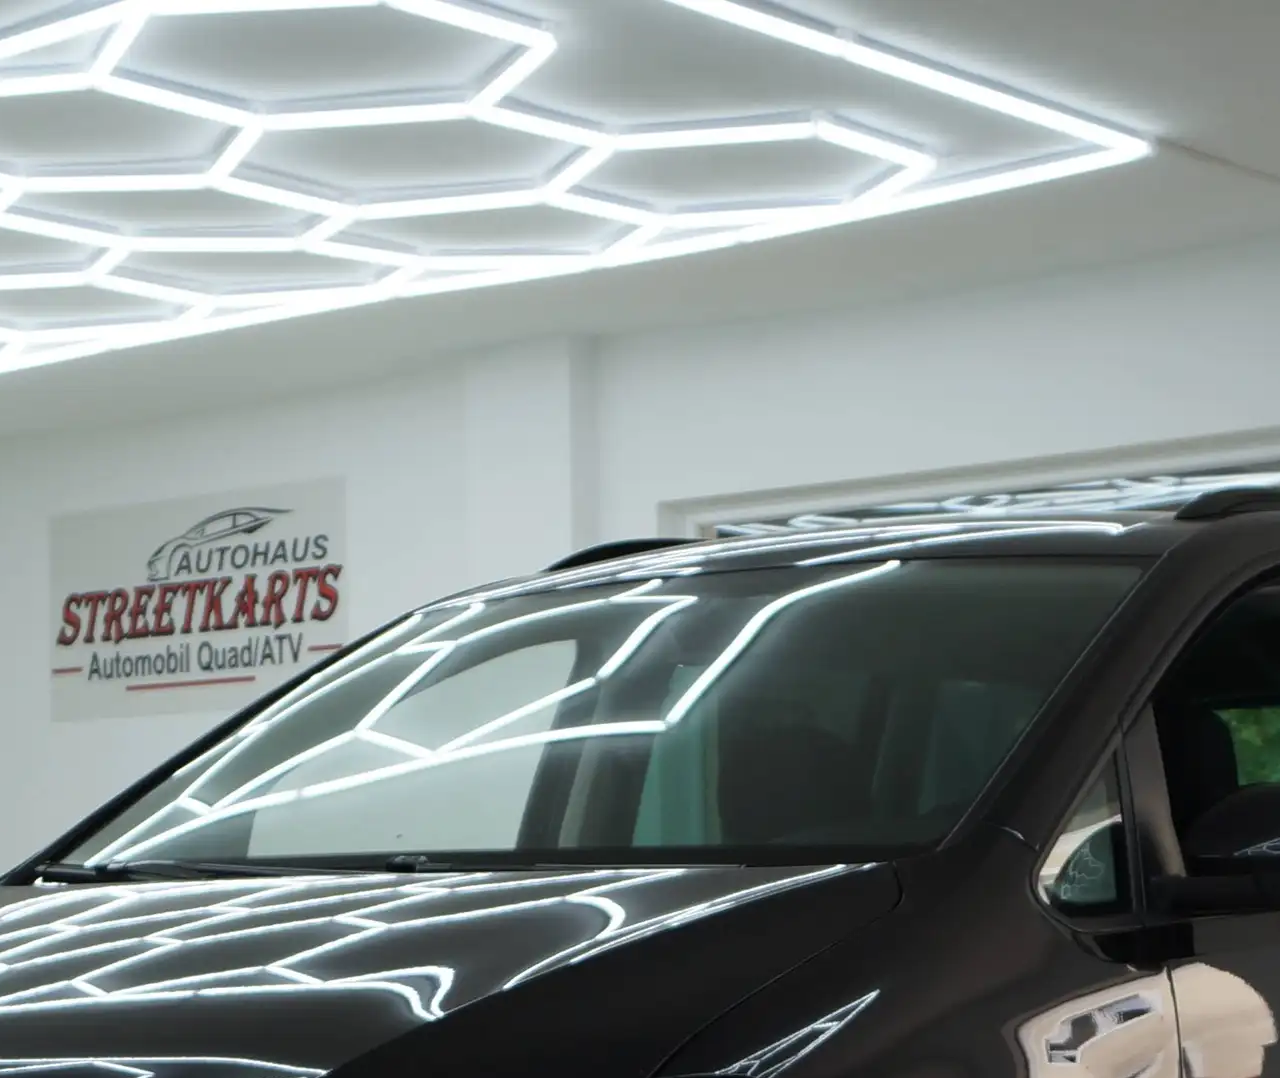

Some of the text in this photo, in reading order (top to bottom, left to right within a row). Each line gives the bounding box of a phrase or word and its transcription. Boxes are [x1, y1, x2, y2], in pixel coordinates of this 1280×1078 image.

[174, 534, 329, 577] AUTOHAUS
[56, 564, 343, 646] STREETKARTS
[88, 633, 303, 680] Automobil Quad/ATV
